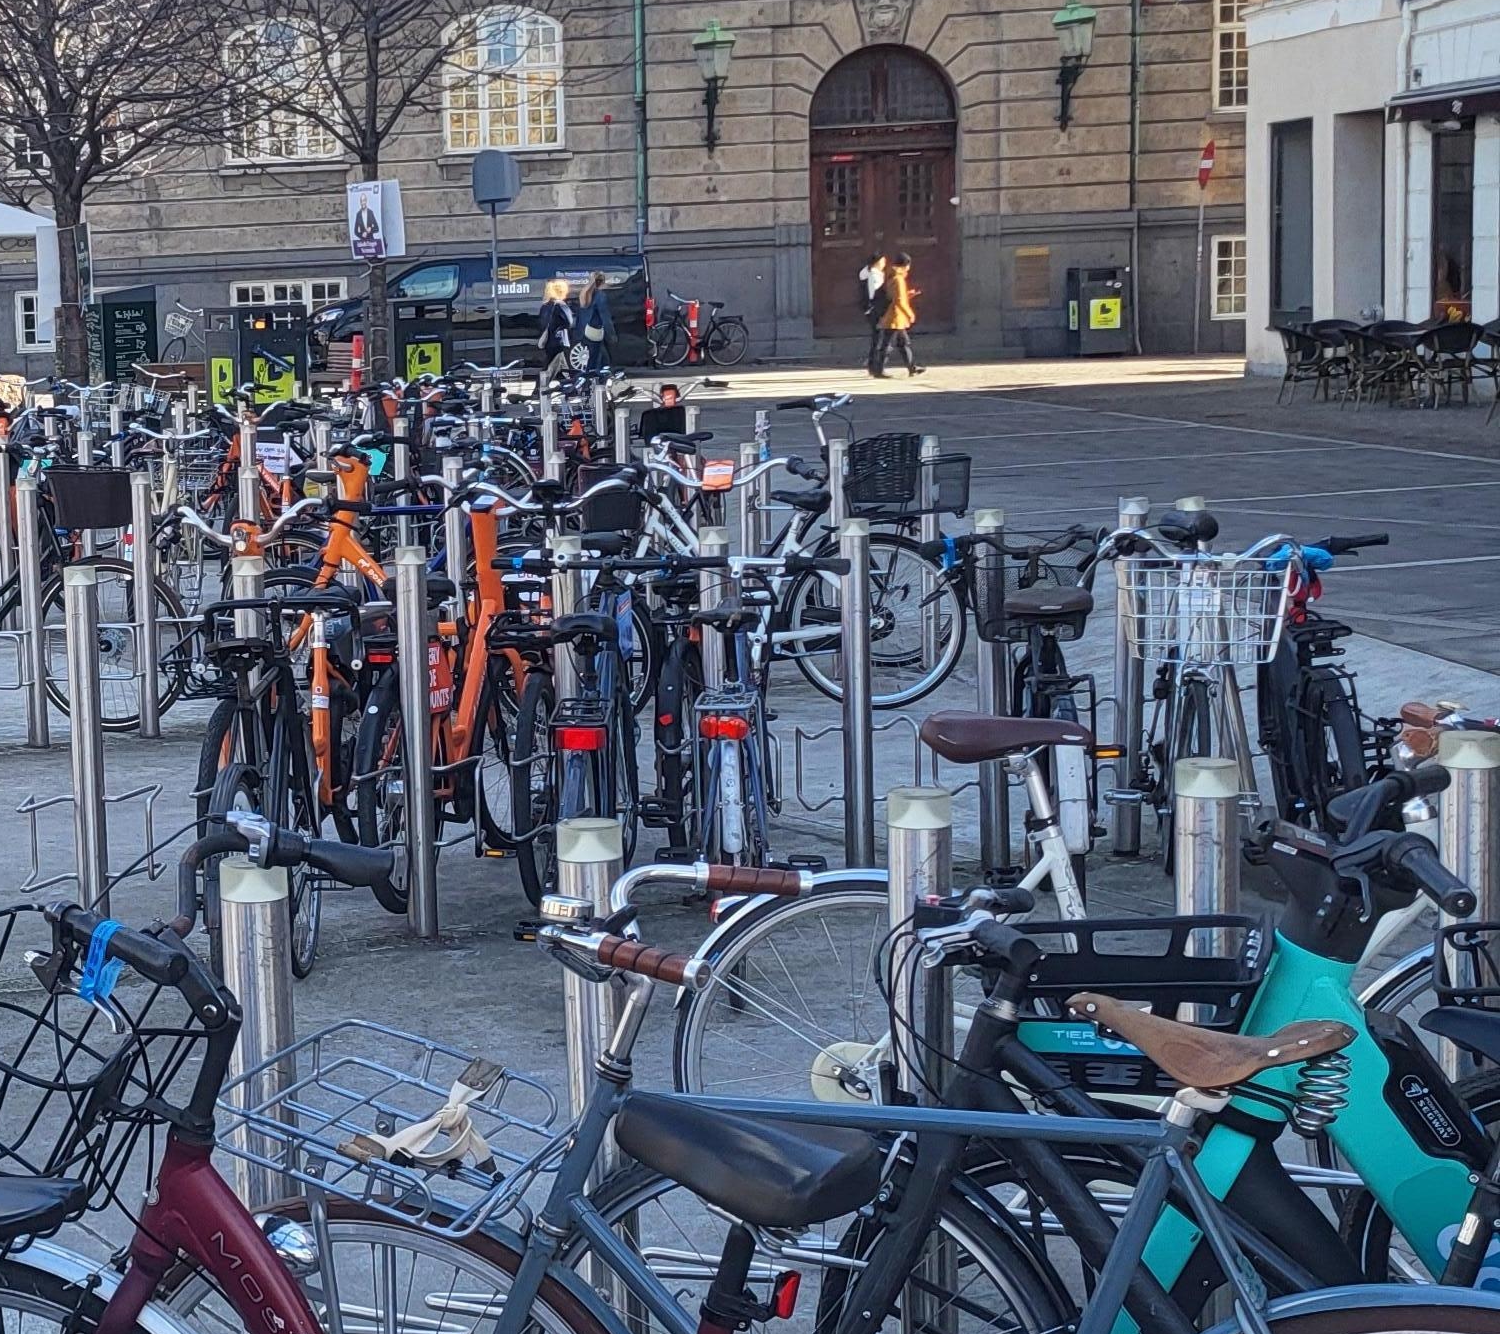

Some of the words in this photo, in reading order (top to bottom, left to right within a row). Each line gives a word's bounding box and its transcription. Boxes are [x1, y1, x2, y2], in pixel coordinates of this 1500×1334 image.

[1052, 1030, 1095, 1039] TIER
[1417, 1099, 1450, 1141] SEGWAY
[1422, 1095, 1447, 1127] POWERED
